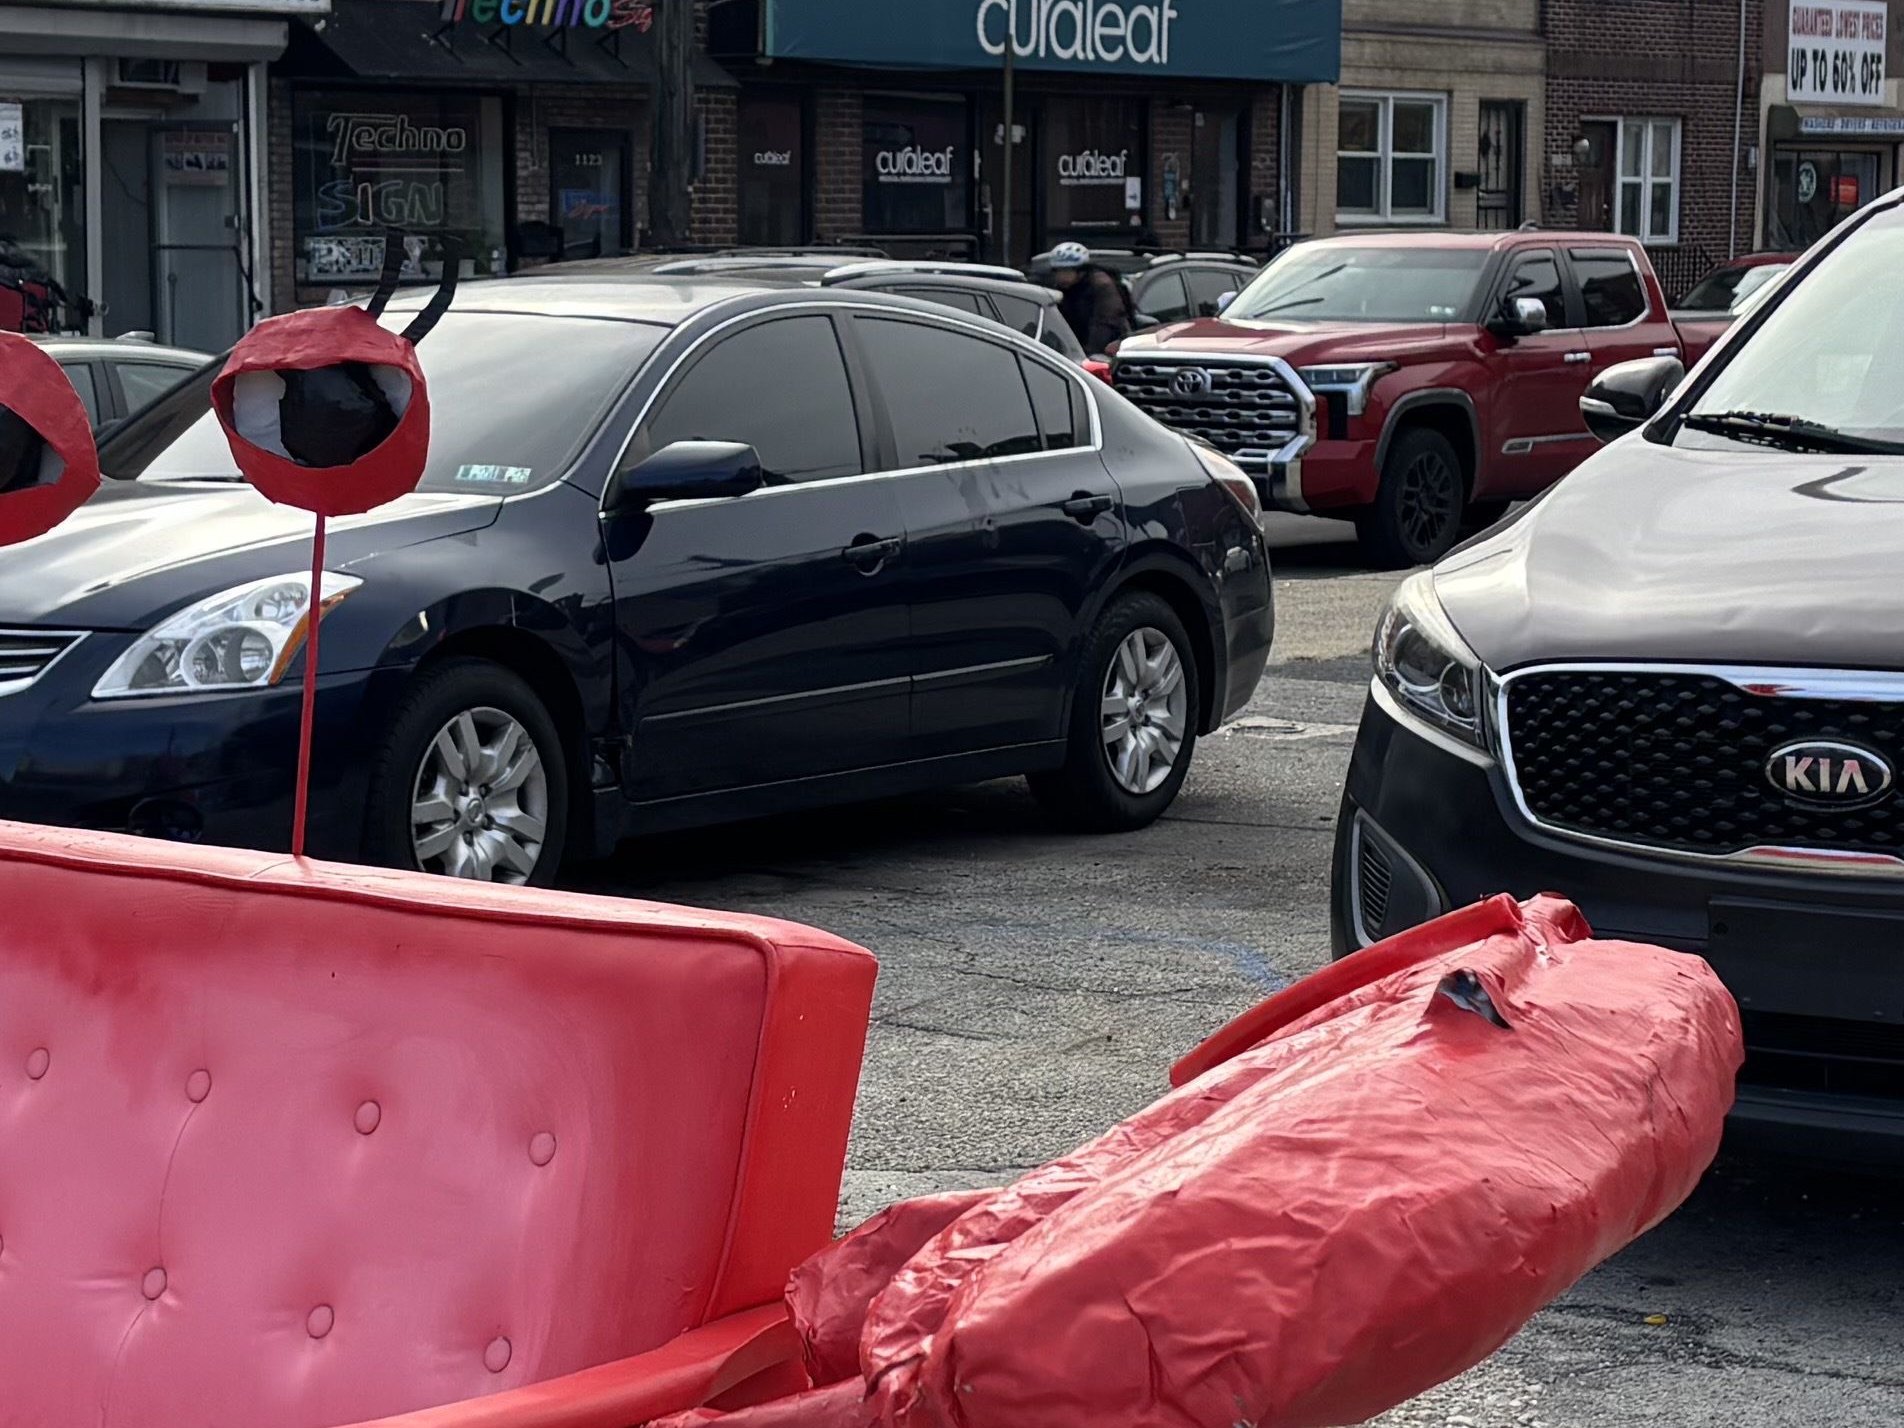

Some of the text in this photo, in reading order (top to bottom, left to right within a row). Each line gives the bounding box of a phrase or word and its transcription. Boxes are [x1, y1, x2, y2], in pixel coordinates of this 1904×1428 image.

[1791, 47, 1807, 91] UP
[1812, 48, 1828, 92] TO
[1861, 51, 1882, 95] OFF
[327, 113, 466, 165] Techno
[875, 145, 954, 175] curaleaf
[1058, 149, 1128, 176] curaleaf
[1785, 755, 1869, 794] KIA
